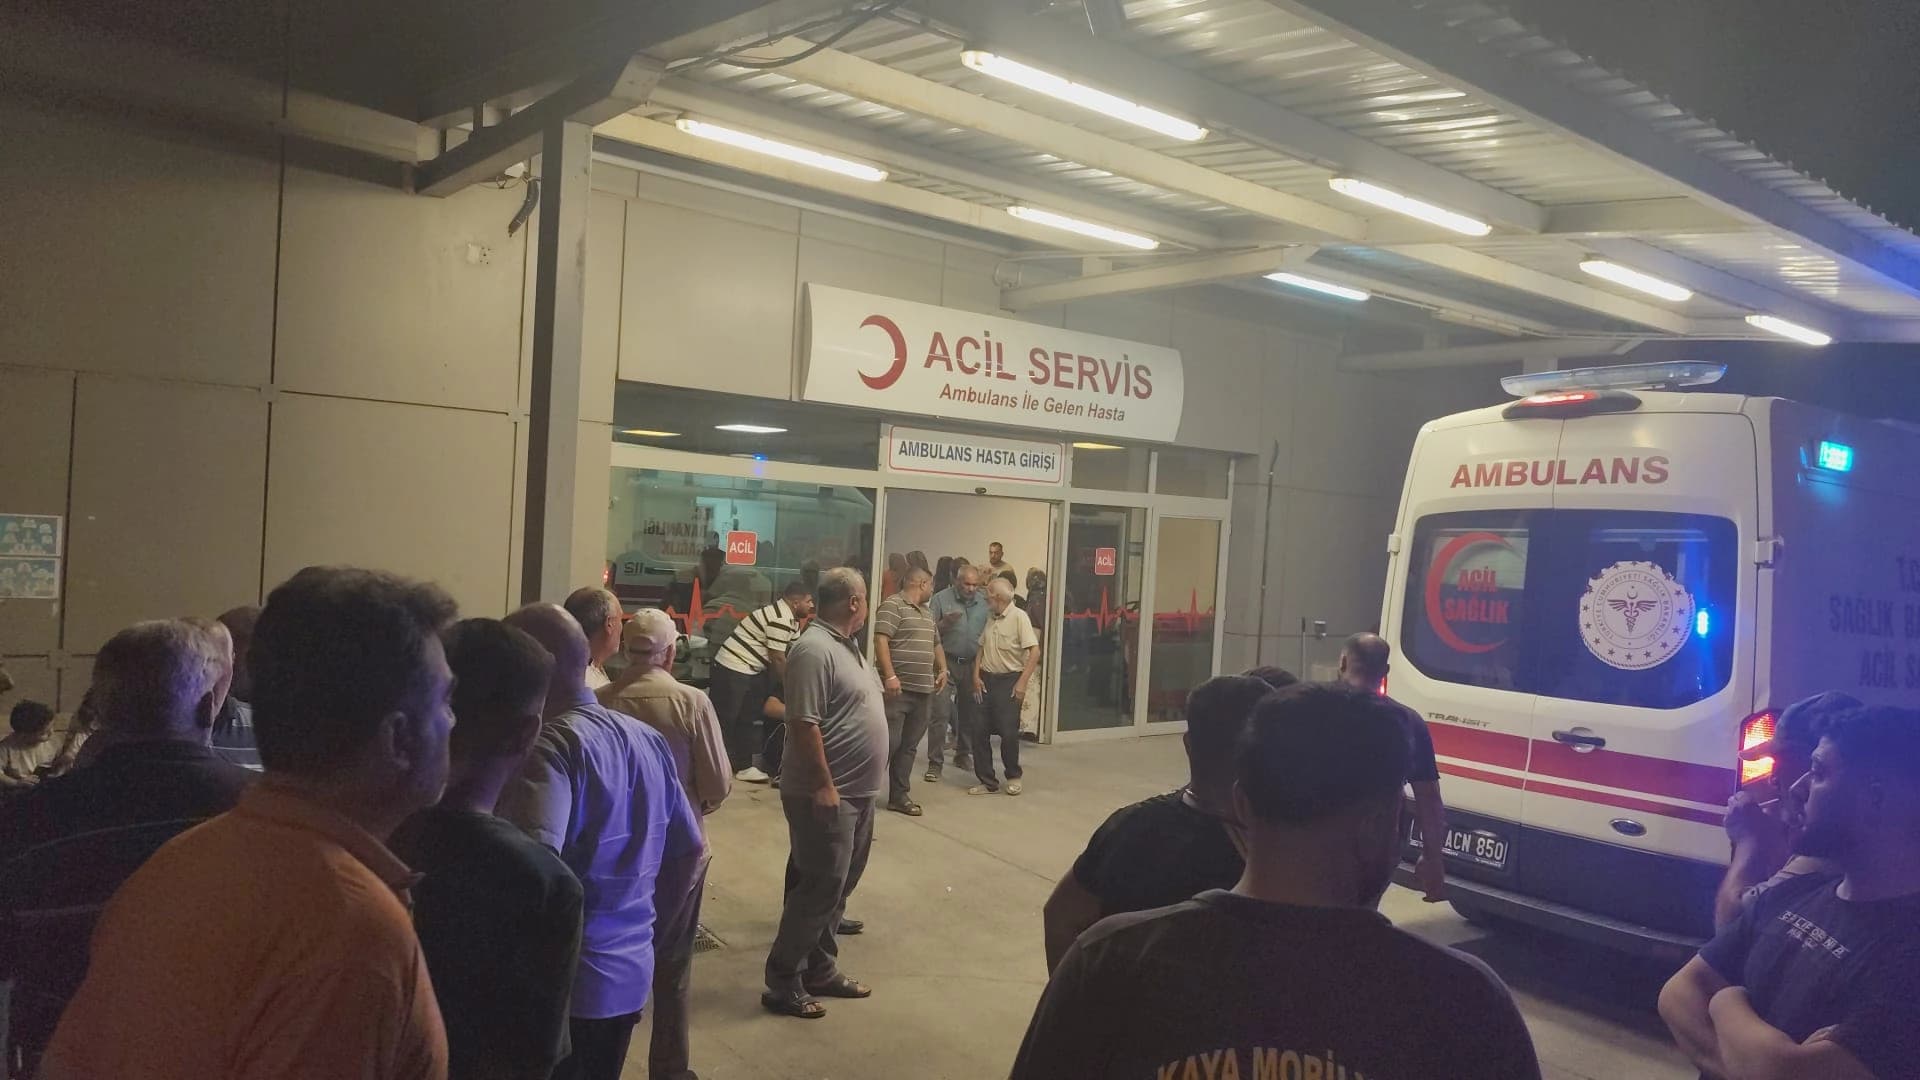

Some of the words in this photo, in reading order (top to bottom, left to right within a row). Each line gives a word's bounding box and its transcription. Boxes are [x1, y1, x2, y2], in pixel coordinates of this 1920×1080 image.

[923, 330, 1017, 381] ACİL
[1027, 346, 1153, 400] SERVİS
[939, 383, 1018, 409] Ambulans
[1021, 389, 1039, 411] İle
[1043, 396, 1084, 417] Gelen
[1087, 402, 1125, 422] Hasta
[898, 440, 972, 463] AMBULANS
[975, 447, 1017, 467] HASTA
[1019, 446, 1056, 471] GİRİŞİ
[1449, 455, 1670, 489] AMBULANS
[729, 539, 754, 555] ACİL
[1097, 553, 1113, 566] ACİL
[1456, 565, 1497, 593] ACİL
[1445, 595, 1509, 624] SAĞLIK
[1829, 590, 1894, 637] SAĞLIK
[1427, 712, 1491, 728] TRANSIT
[1444, 830, 1471, 853] ACN
[1475, 837, 1504, 861] 850
[1157, 1047, 1241, 1080] KAYA
